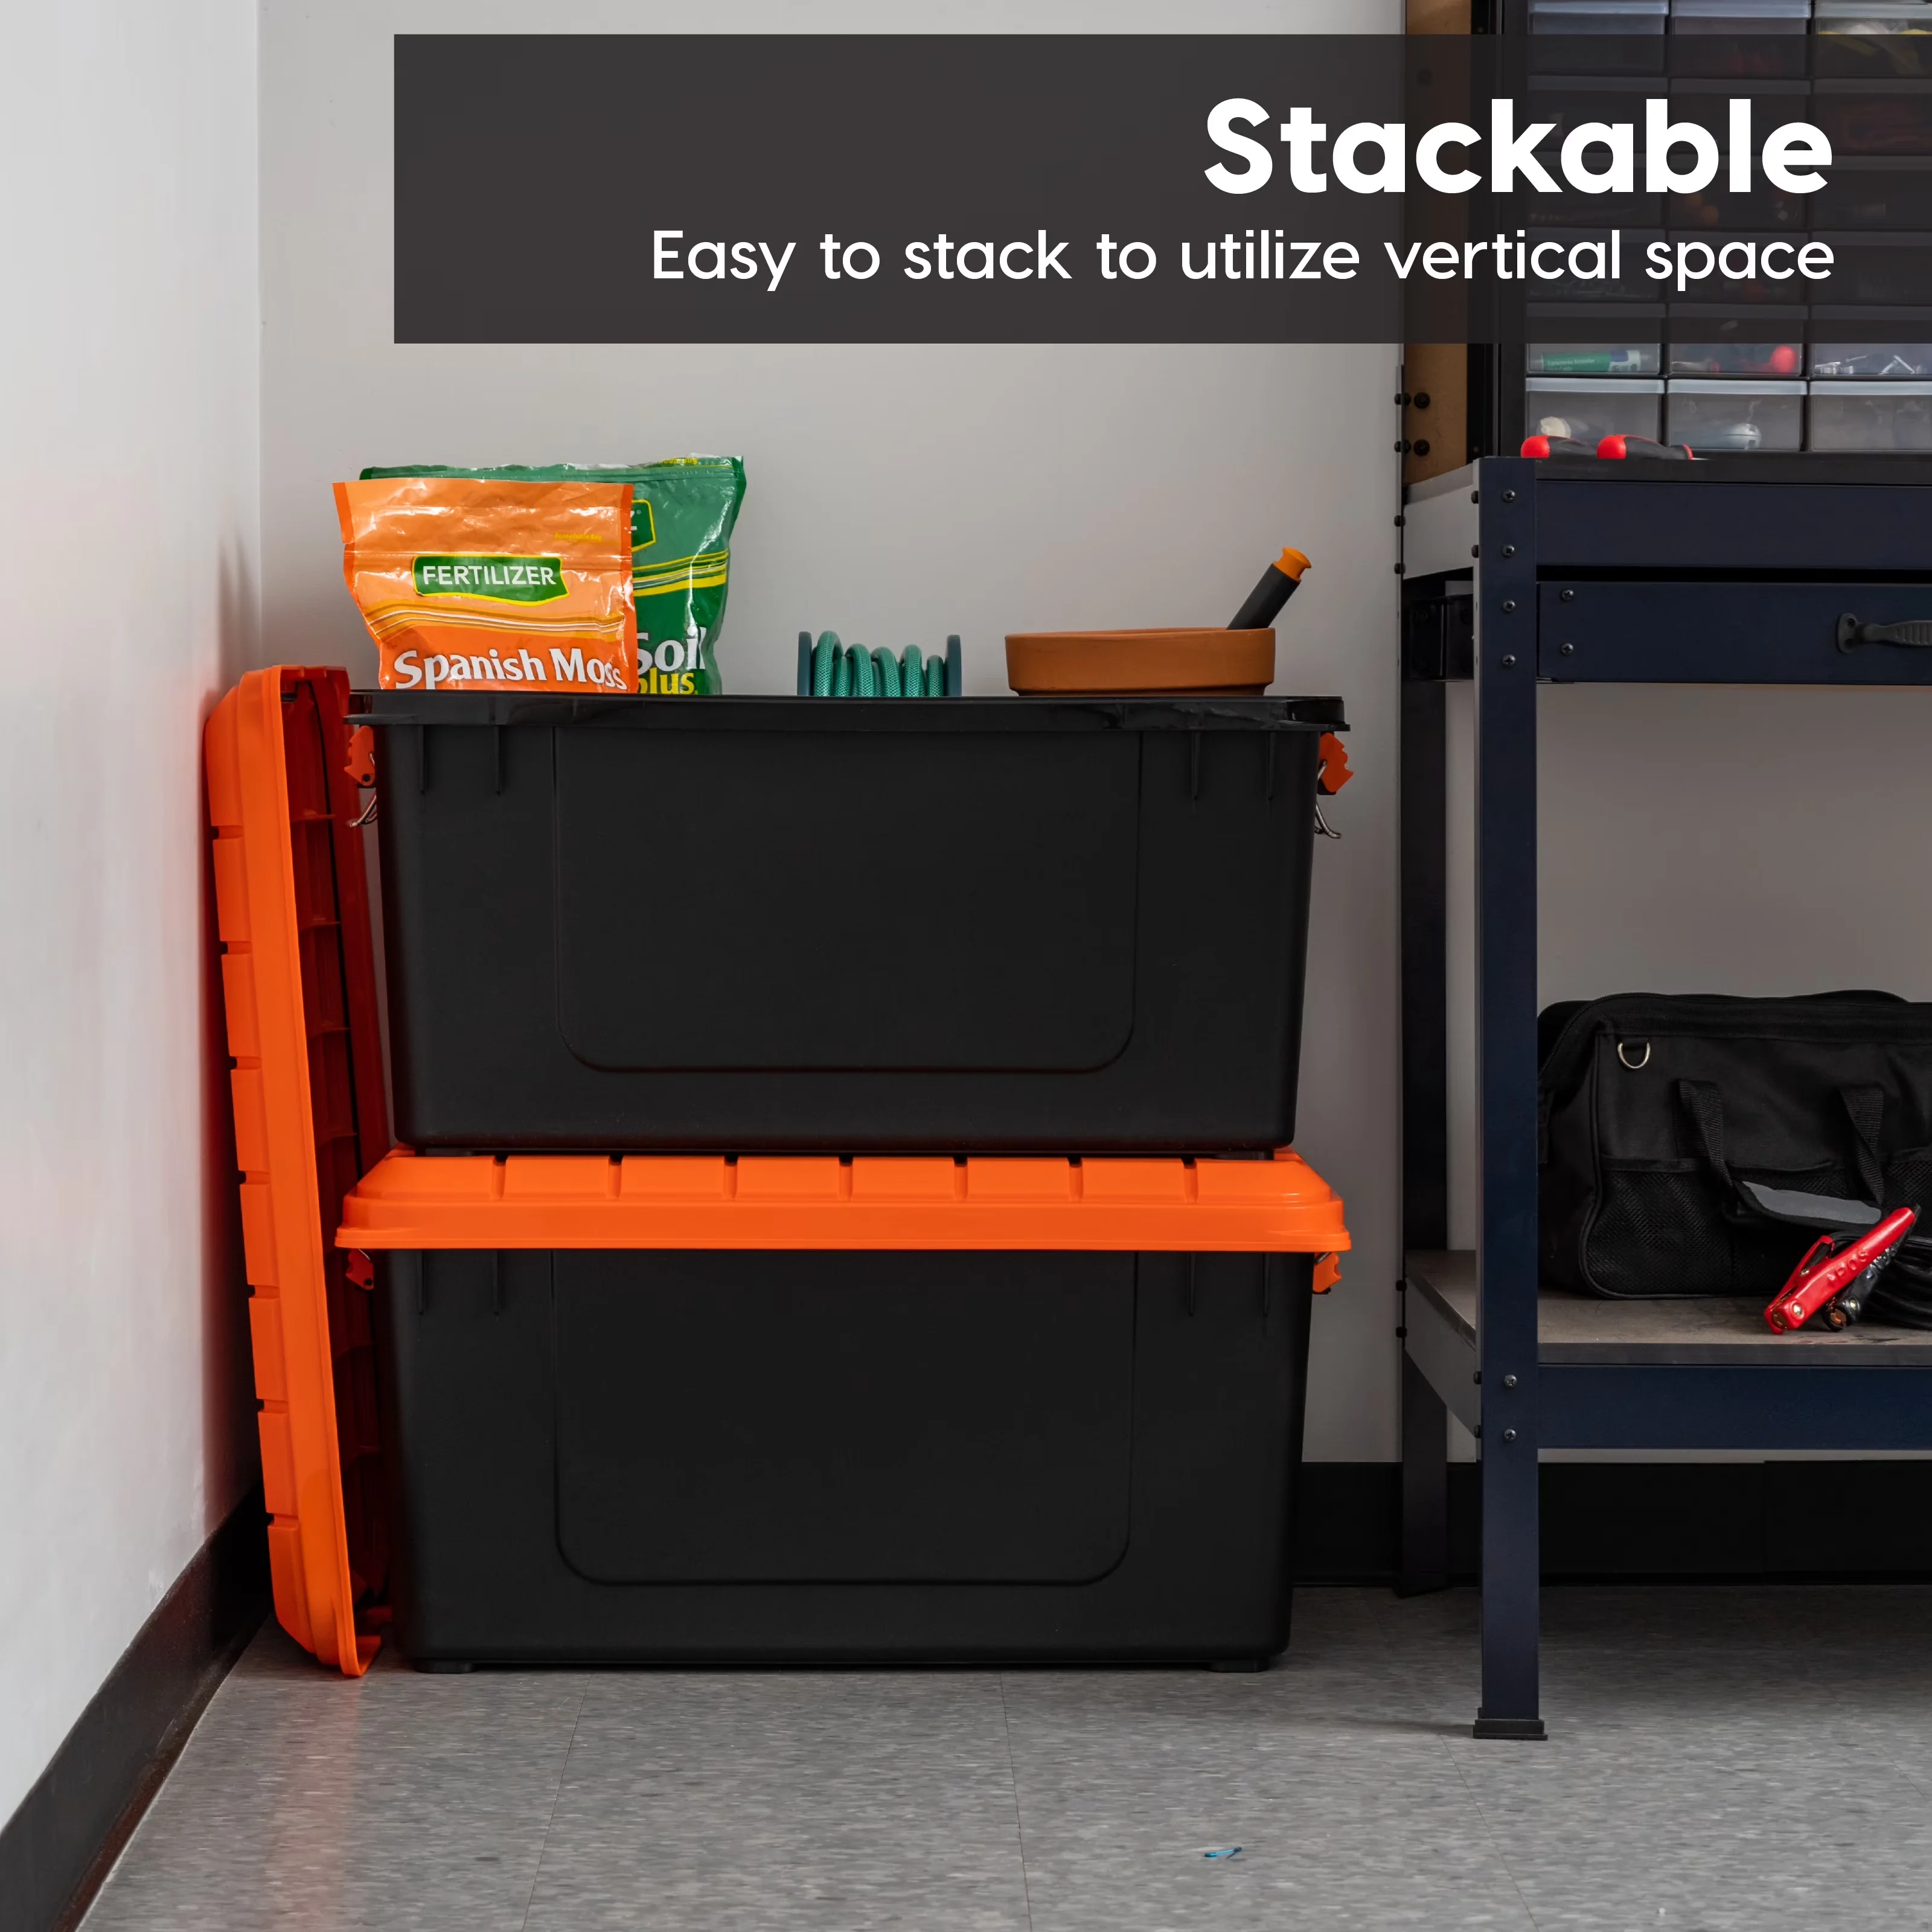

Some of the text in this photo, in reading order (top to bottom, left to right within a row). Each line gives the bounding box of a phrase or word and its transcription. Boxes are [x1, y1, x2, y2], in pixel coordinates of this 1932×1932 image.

[423, 566, 556, 585] FERTILIZER
[394, 648, 627, 691] Spanish Moss
